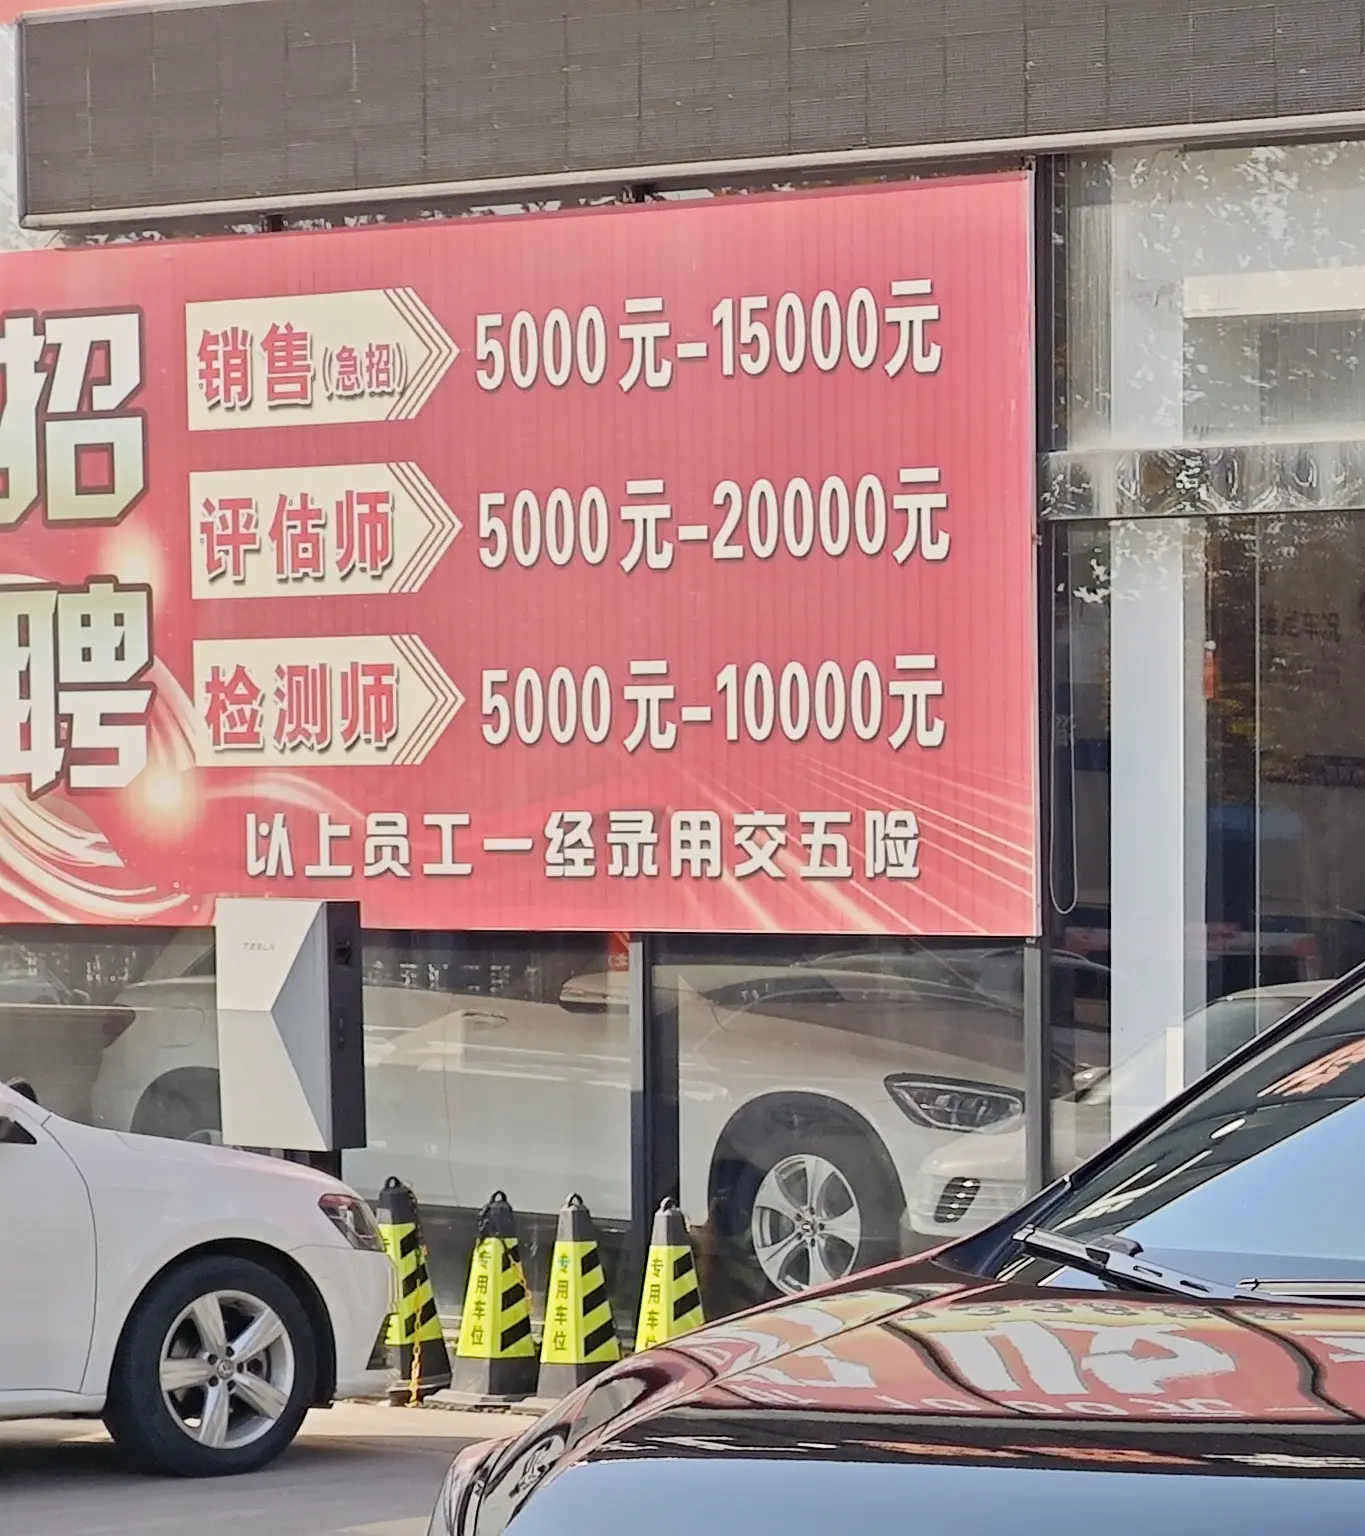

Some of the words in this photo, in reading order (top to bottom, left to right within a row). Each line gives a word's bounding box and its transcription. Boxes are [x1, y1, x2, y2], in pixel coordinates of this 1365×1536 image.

[199, 488, 398, 581] 评估师
[204, 661, 402, 755] 检测师
[245, 809, 921, 879] 以上员工一经录用交五险
[470, 1247, 493, 1347] 专用车位
[552, 1253, 573, 1352] 专用车位
